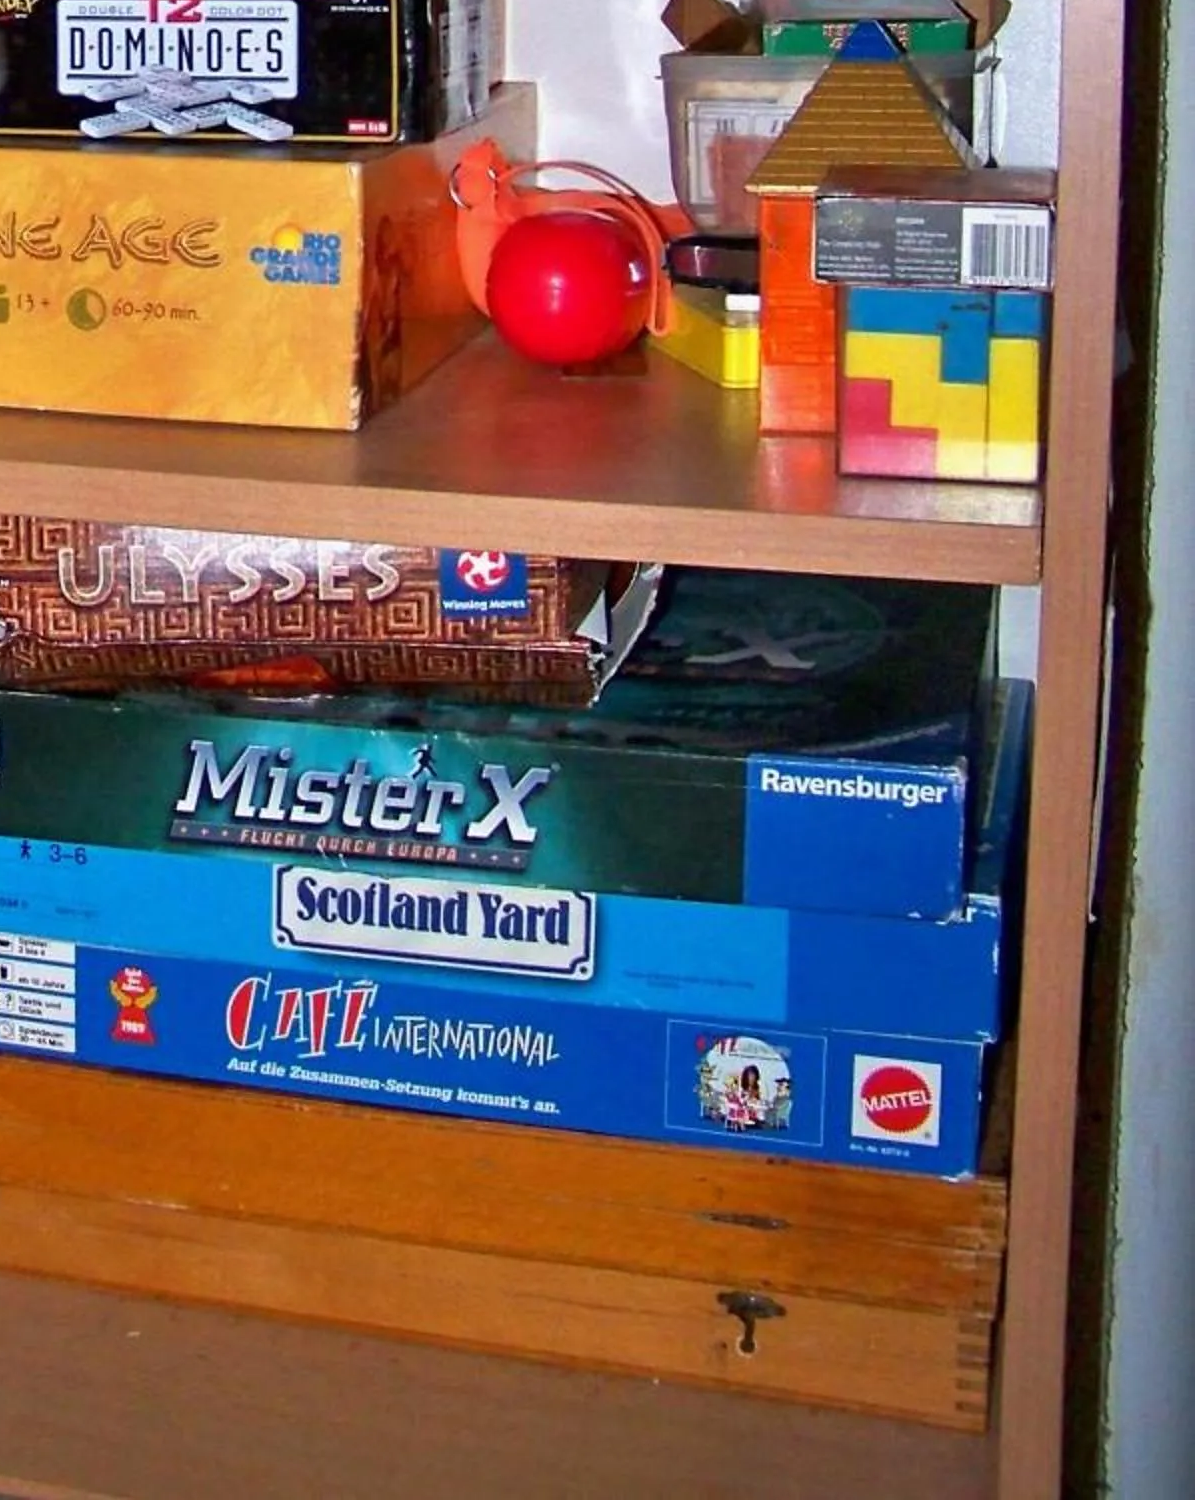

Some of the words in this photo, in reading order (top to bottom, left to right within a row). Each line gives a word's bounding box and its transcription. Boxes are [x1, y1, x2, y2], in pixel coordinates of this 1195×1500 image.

[78, 4, 133, 16] DOUBLE
[208, 6, 254, 18] COLOR
[257, 7, 284, 18] DOT
[70, 213, 223, 271] AGE
[249, 246, 340, 267] GRANDE
[302, 232, 340, 249] RIO
[263, 264, 340, 284] GAMES
[111, 298, 166, 320] 60-90
[57, 543, 401, 606] ULYSSES
[175, 739, 466, 836] Mister
[466, 763, 553, 843] X
[761, 767, 948, 808] Ravensburger
[238, 828, 306, 847] FLUCHT
[315, 835, 377, 854] DURCH
[387, 842, 459, 862] EUROPA
[295, 875, 469, 937] Scotland
[476, 891, 571, 946] Yard
[226, 971, 379, 1058] CAFÉ
[374, 1014, 561, 1067] INTERNATIONAL
[226, 1057, 258, 1073] Auf
[260, 1058, 287, 1078] die
[288, 1063, 454, 1102] Zusammen-Setzung
[456, 1087, 531, 1111] kommt's
[532, 1098, 562, 1114] an.
[860, 1089, 934, 1113] MATTEL
